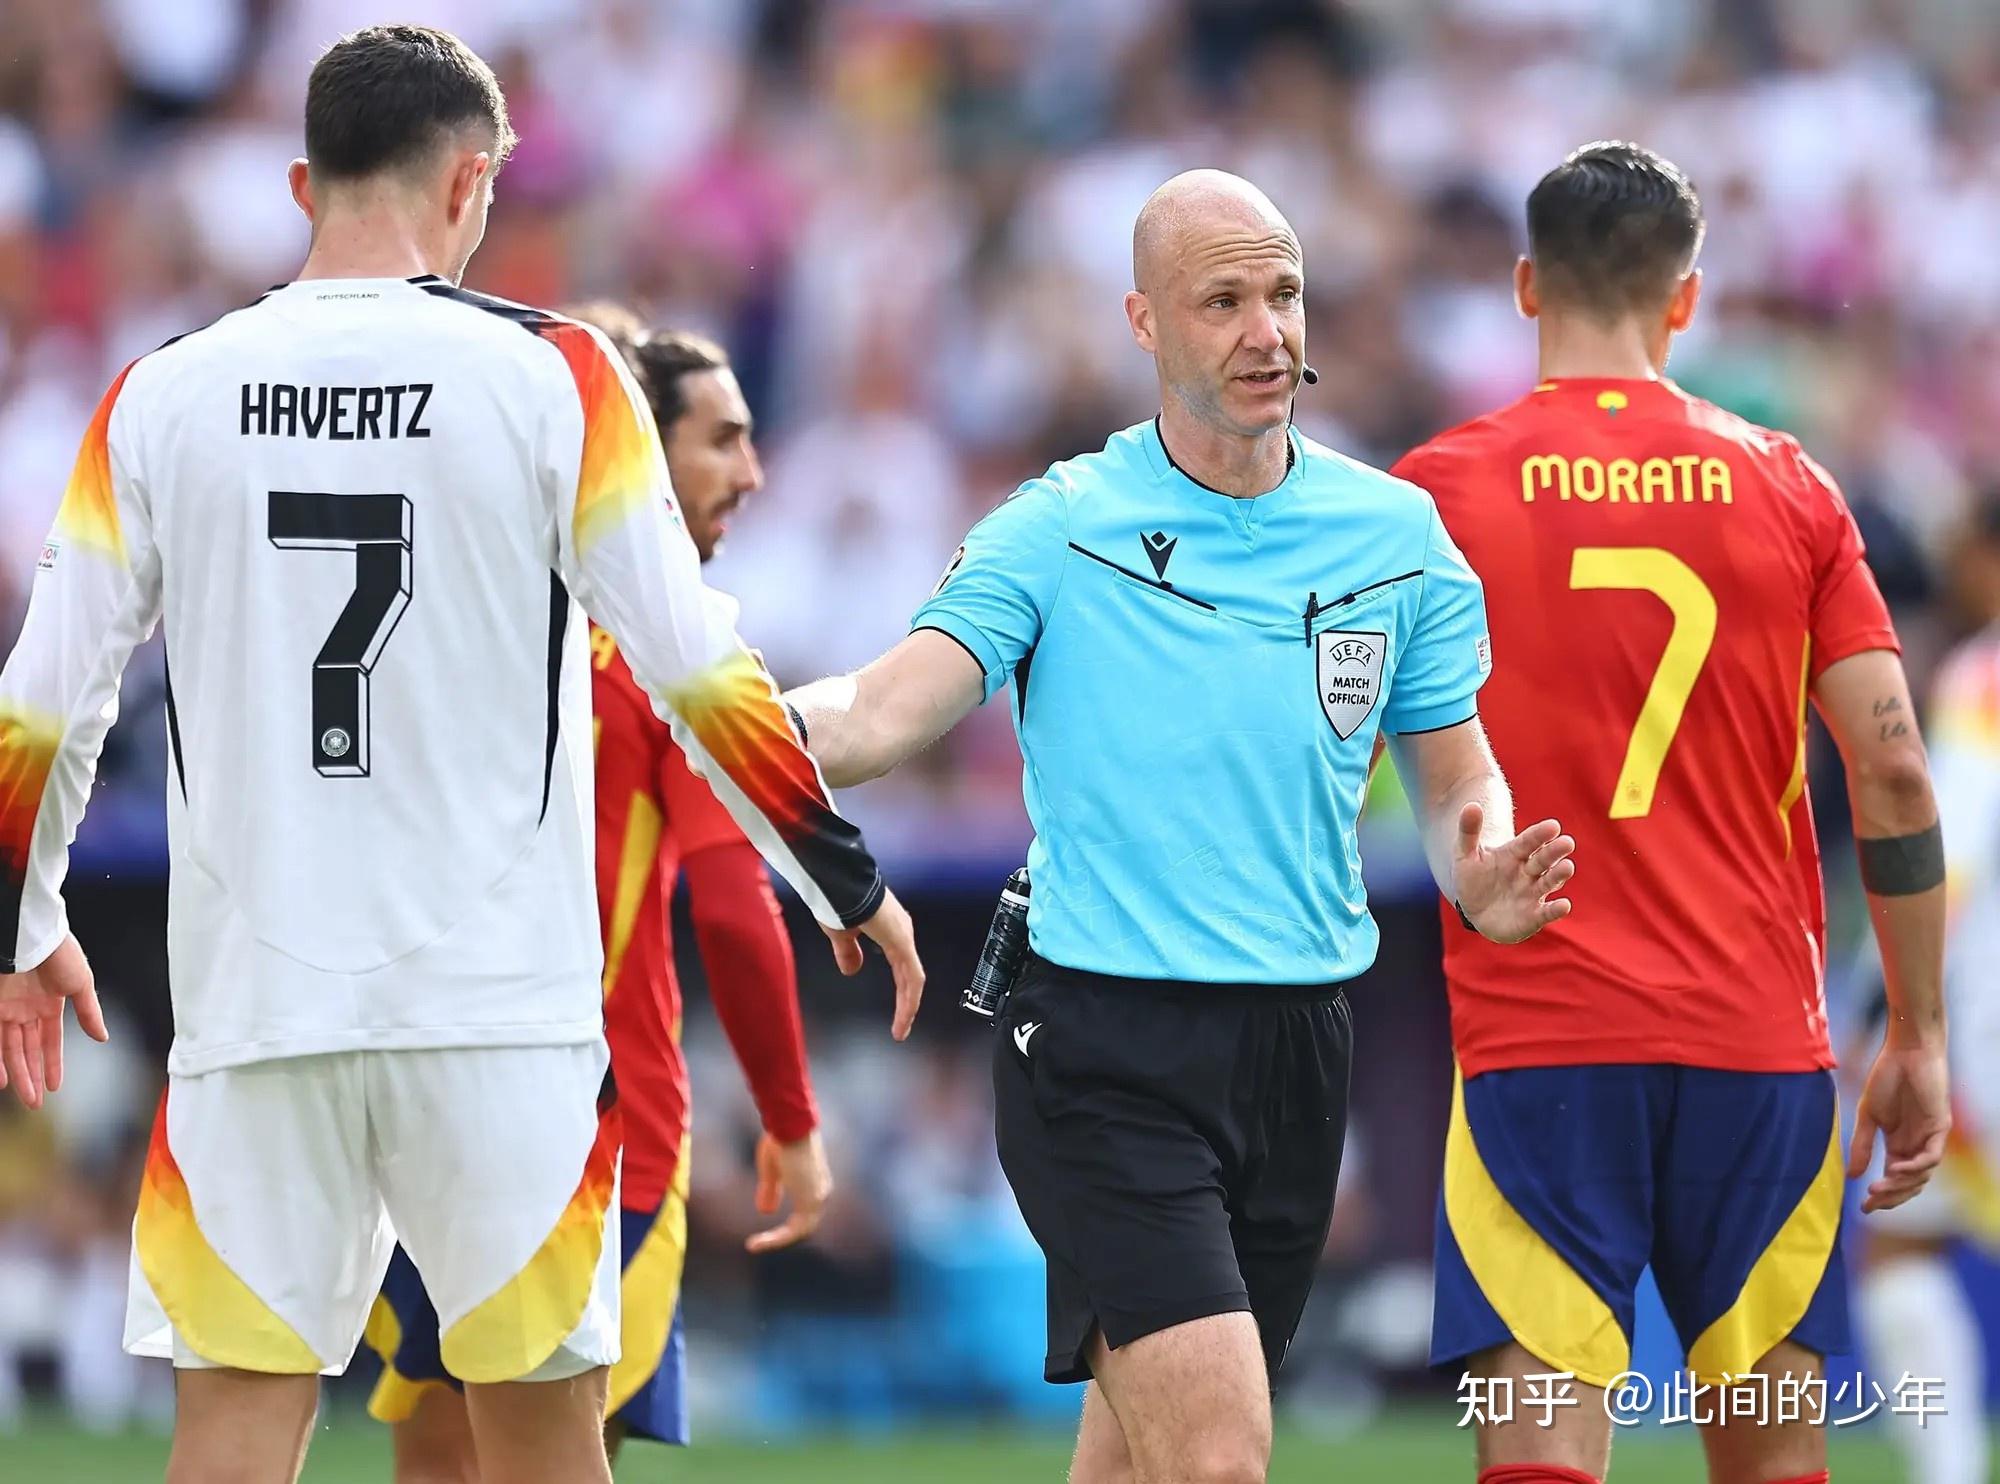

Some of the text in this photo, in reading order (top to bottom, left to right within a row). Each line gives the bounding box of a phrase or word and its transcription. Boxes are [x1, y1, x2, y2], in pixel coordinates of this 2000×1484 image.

[241, 383, 434, 440] HAVERTZ
[1521, 453, 1733, 504] MORATA
[267, 490, 414, 778] 7
[1331, 643, 1372, 665] UEFA
[1327, 692, 1370, 705] OFFICIAL
[1332, 676, 1370, 690] MATCH
[1569, 547, 1718, 819] 7
